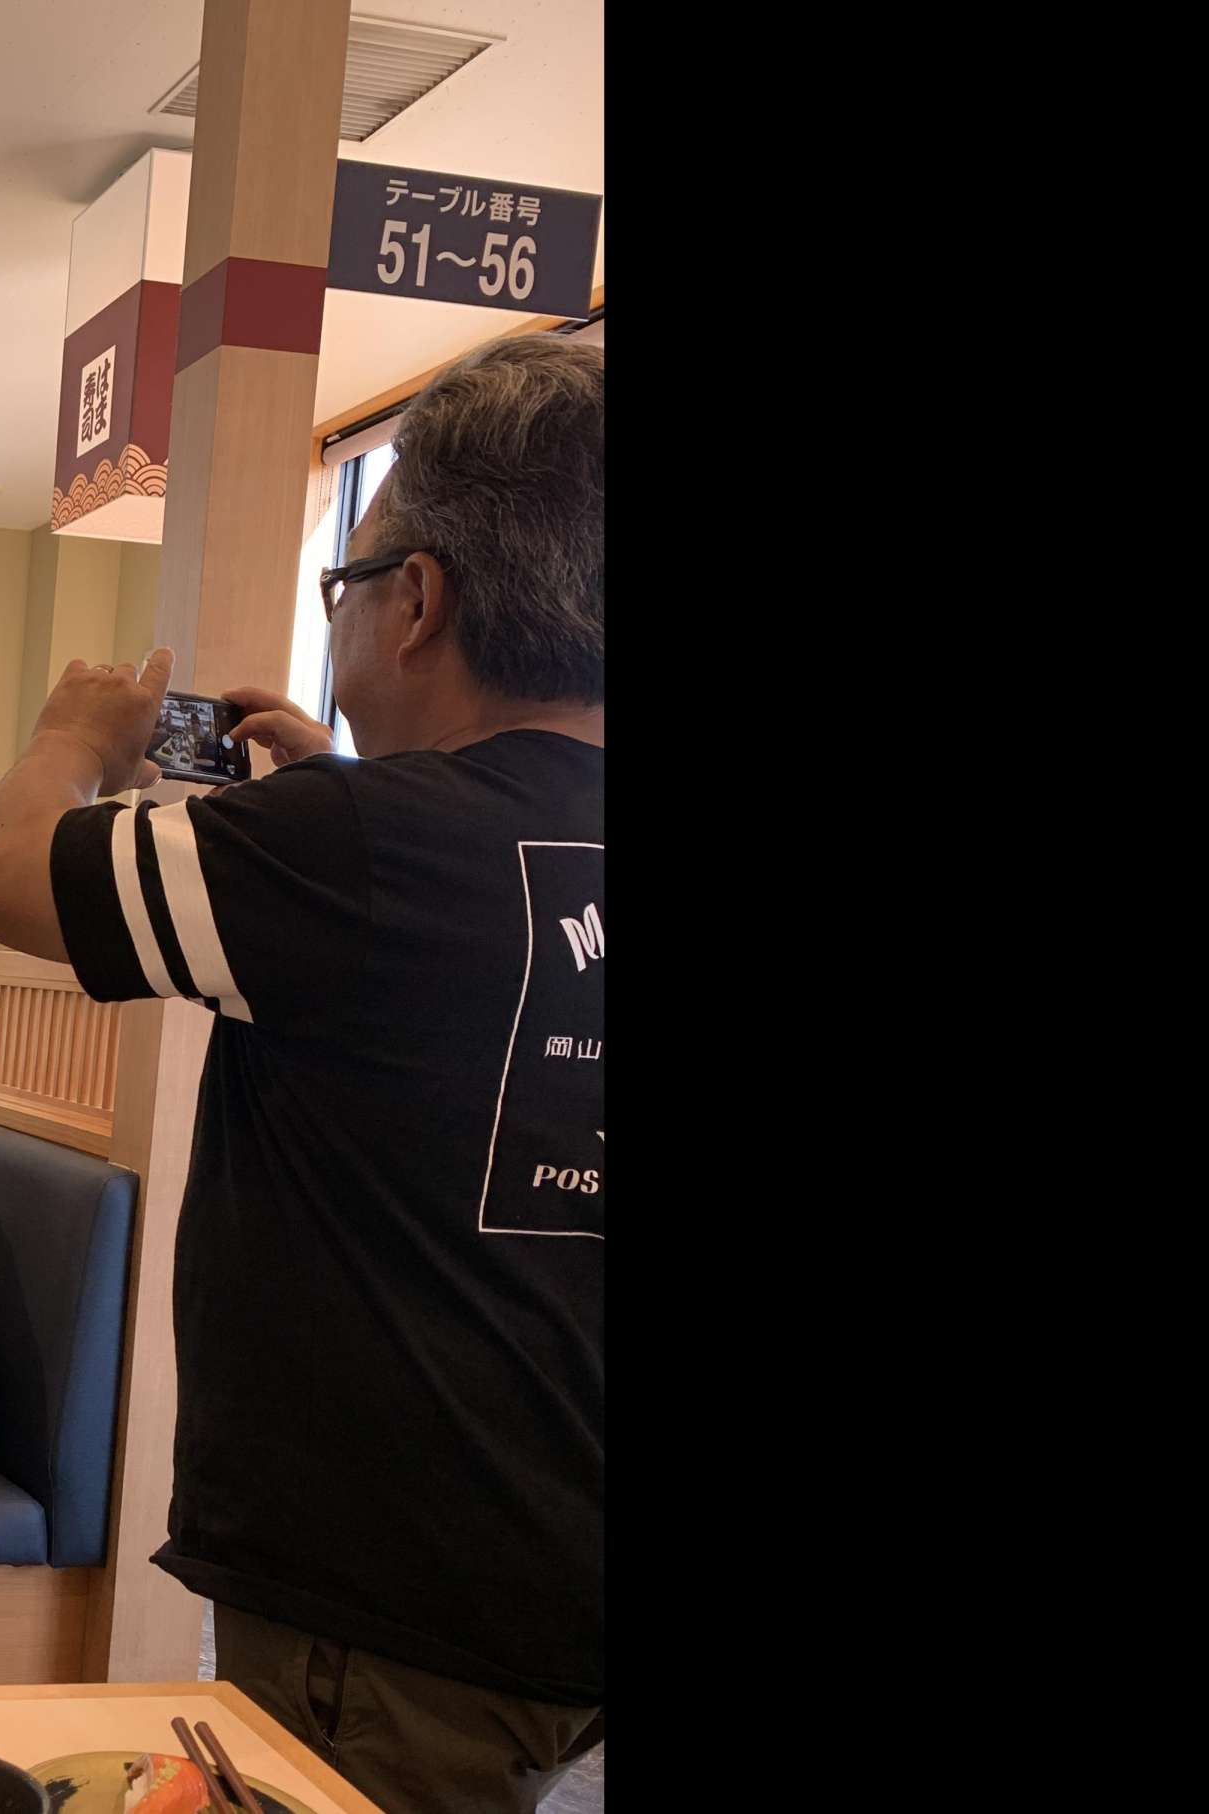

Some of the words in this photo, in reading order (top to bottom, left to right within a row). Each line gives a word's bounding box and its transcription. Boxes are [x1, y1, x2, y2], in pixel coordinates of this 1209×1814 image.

[386, 179, 541, 226] テーブル番号
[81, 372, 97, 442] 寿司
[94, 358, 111, 435] はま
[544, 1036, 601, 1061] 岡山
[533, 1164, 599, 1194] POS
